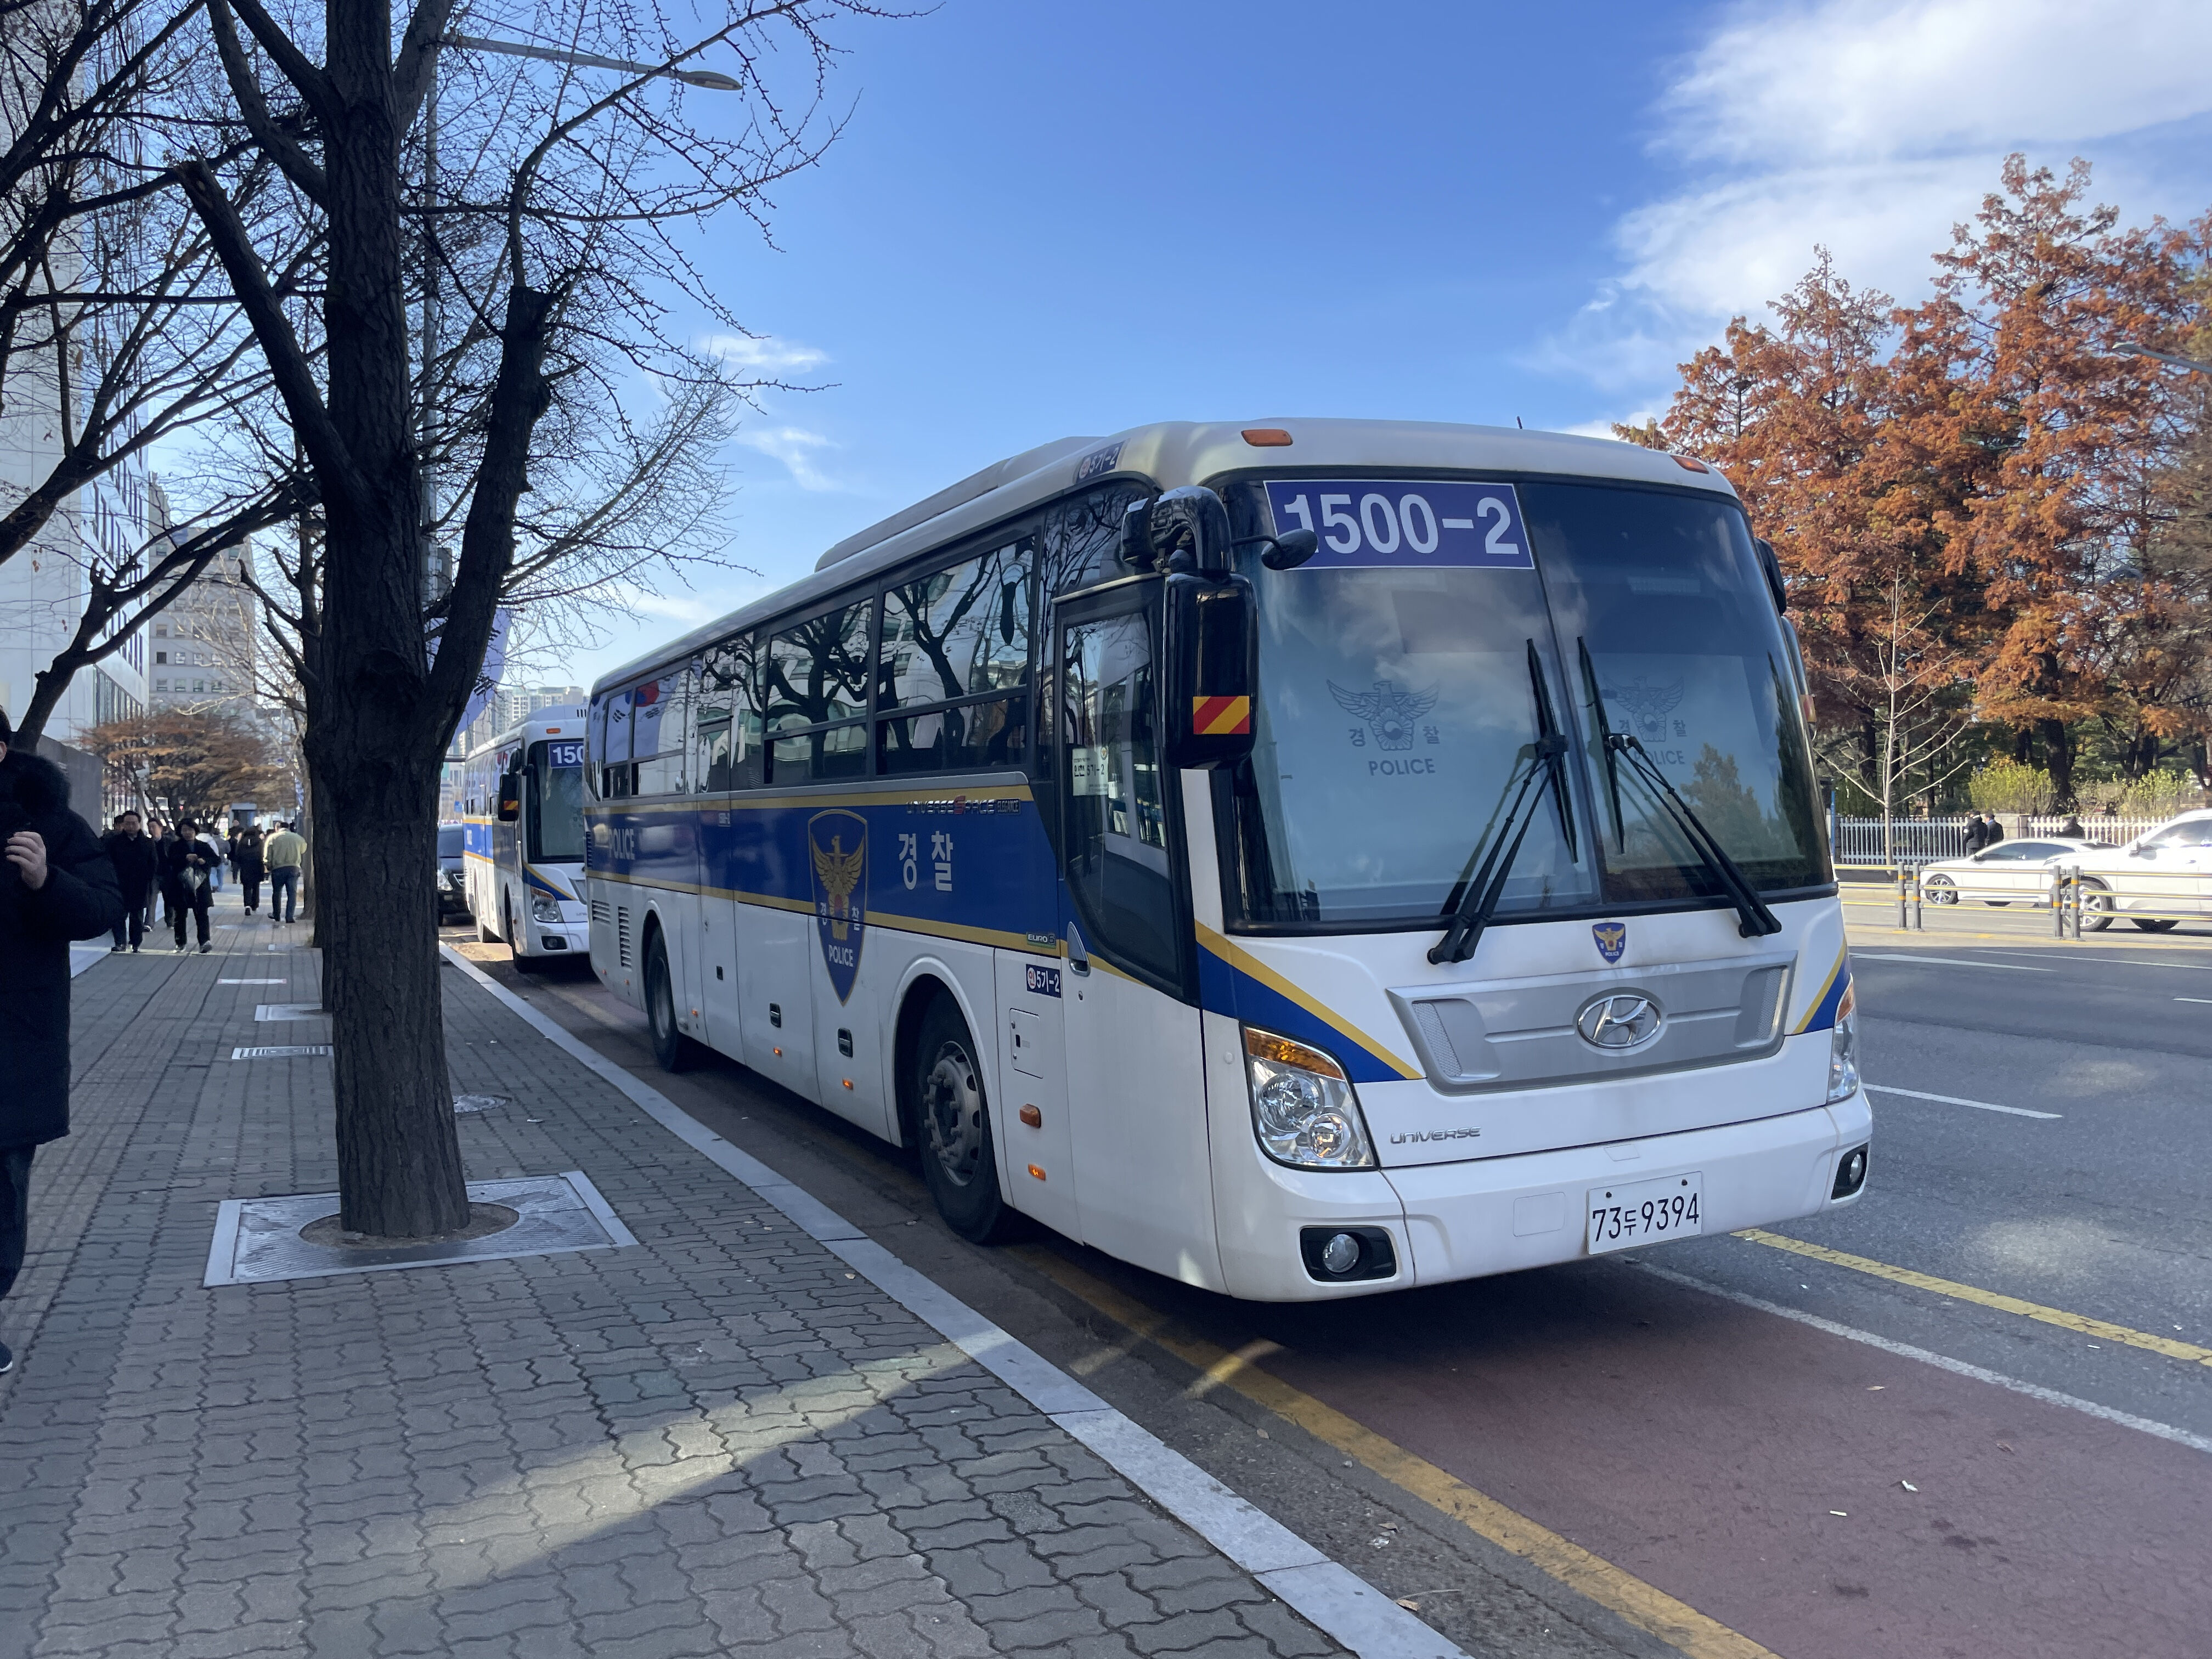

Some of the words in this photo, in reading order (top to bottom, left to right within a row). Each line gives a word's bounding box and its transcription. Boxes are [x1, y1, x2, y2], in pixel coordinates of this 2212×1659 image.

[1284, 493, 1519, 554] 1500-2
[1368, 759, 1435, 776] POLICE
[608, 828, 635, 860] POLICE
[1028, 934, 1047, 943] EURO
[828, 944, 854, 967] POLICE
[1390, 1126, 1481, 1144] UNIVERSE
[1592, 1193, 1700, 1242] 73두9394
